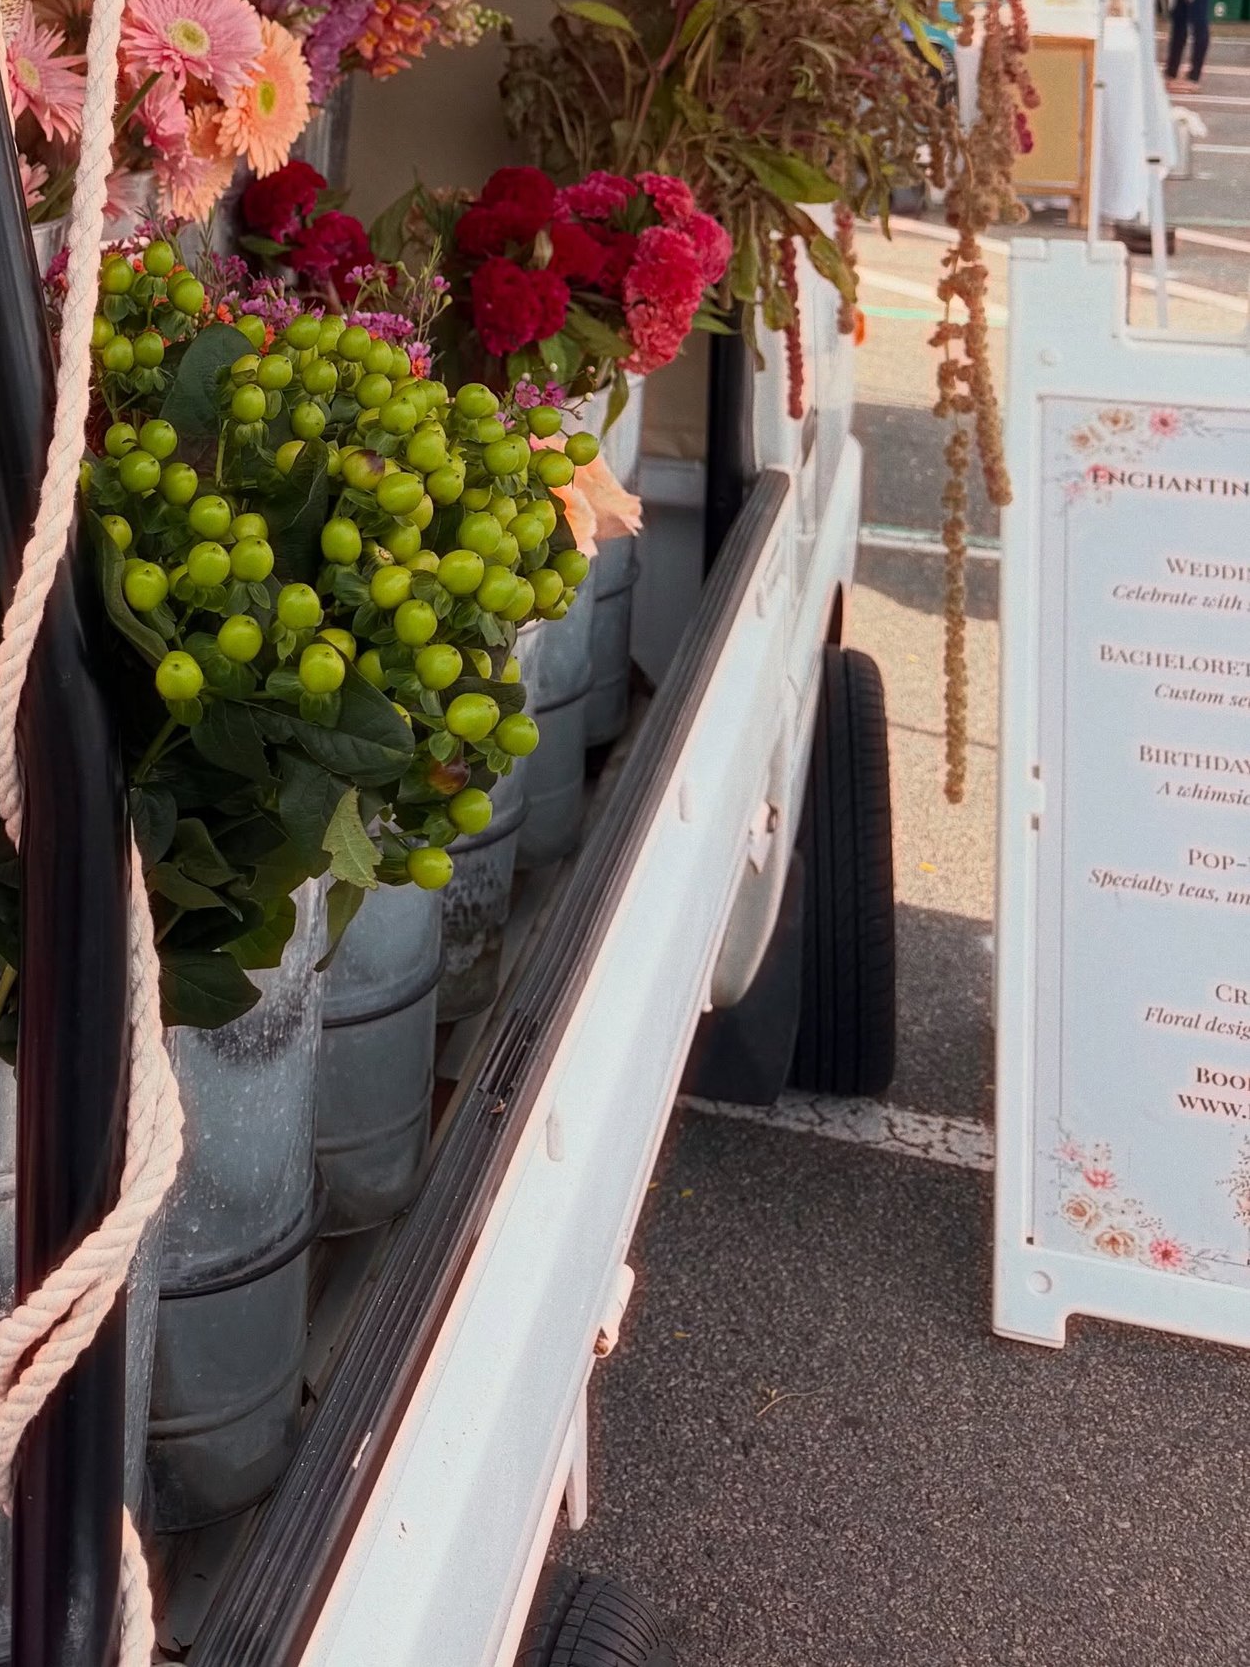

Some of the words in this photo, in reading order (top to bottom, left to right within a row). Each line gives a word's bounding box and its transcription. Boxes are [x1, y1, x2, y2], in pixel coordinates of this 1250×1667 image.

[1166, 557, 1250, 581] WEDDI
[1111, 584, 1198, 607] Celebrate
[1202, 593, 1243, 612] with
[1154, 683, 1225, 705] Custom
[1156, 781, 1170, 796] A
[1188, 848, 1250, 871] POP-
[1088, 868, 1175, 897] Specialty
[1178, 883, 1220, 903] teas,
[1145, 1006, 1202, 1030] Floral
[1196, 1067, 1250, 1092] BOO
